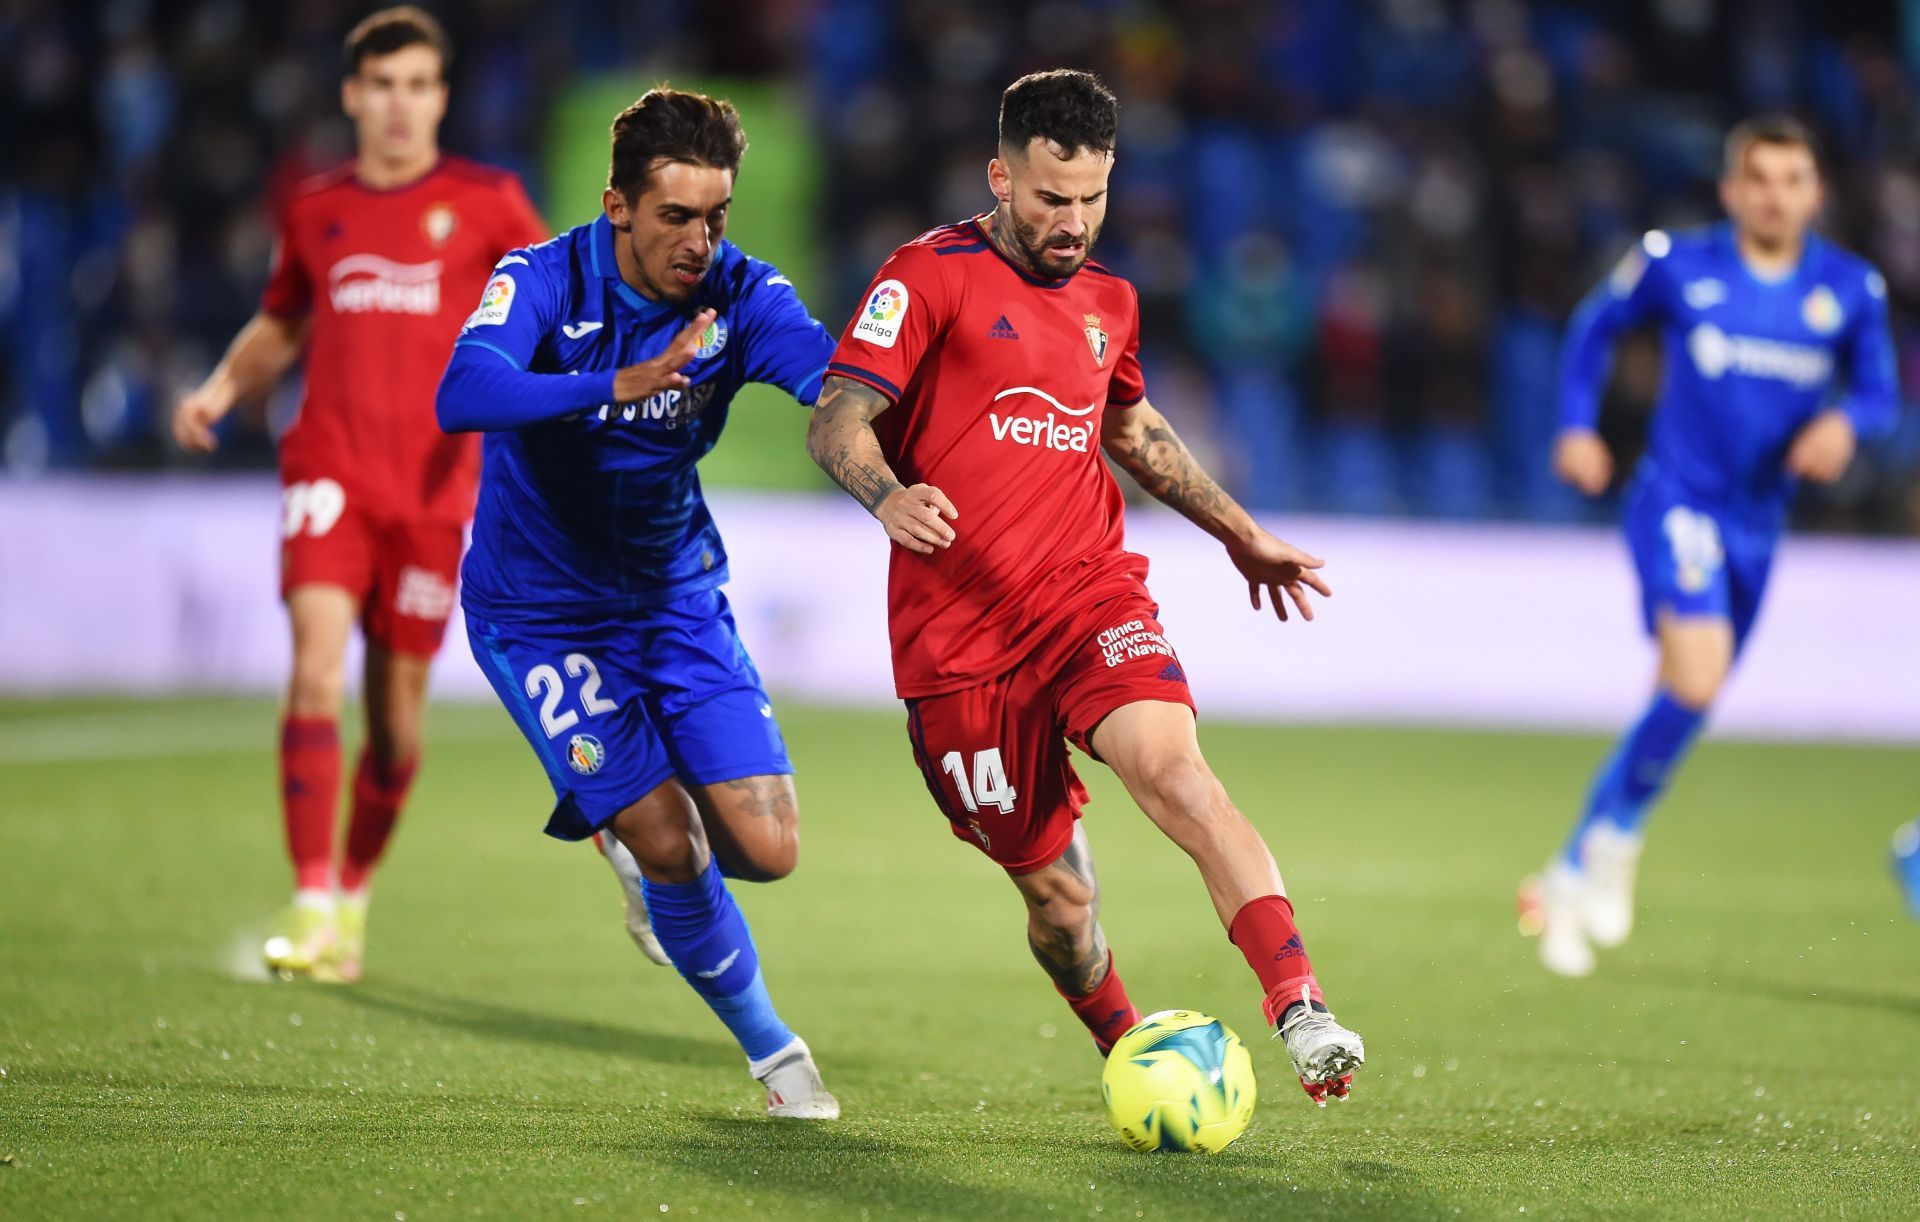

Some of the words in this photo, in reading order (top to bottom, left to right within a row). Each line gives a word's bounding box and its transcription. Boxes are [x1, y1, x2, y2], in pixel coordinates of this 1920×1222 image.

[1105, 653, 1125, 668] de
[525, 653, 619, 740] 22
[941, 747, 1017, 815] 14
